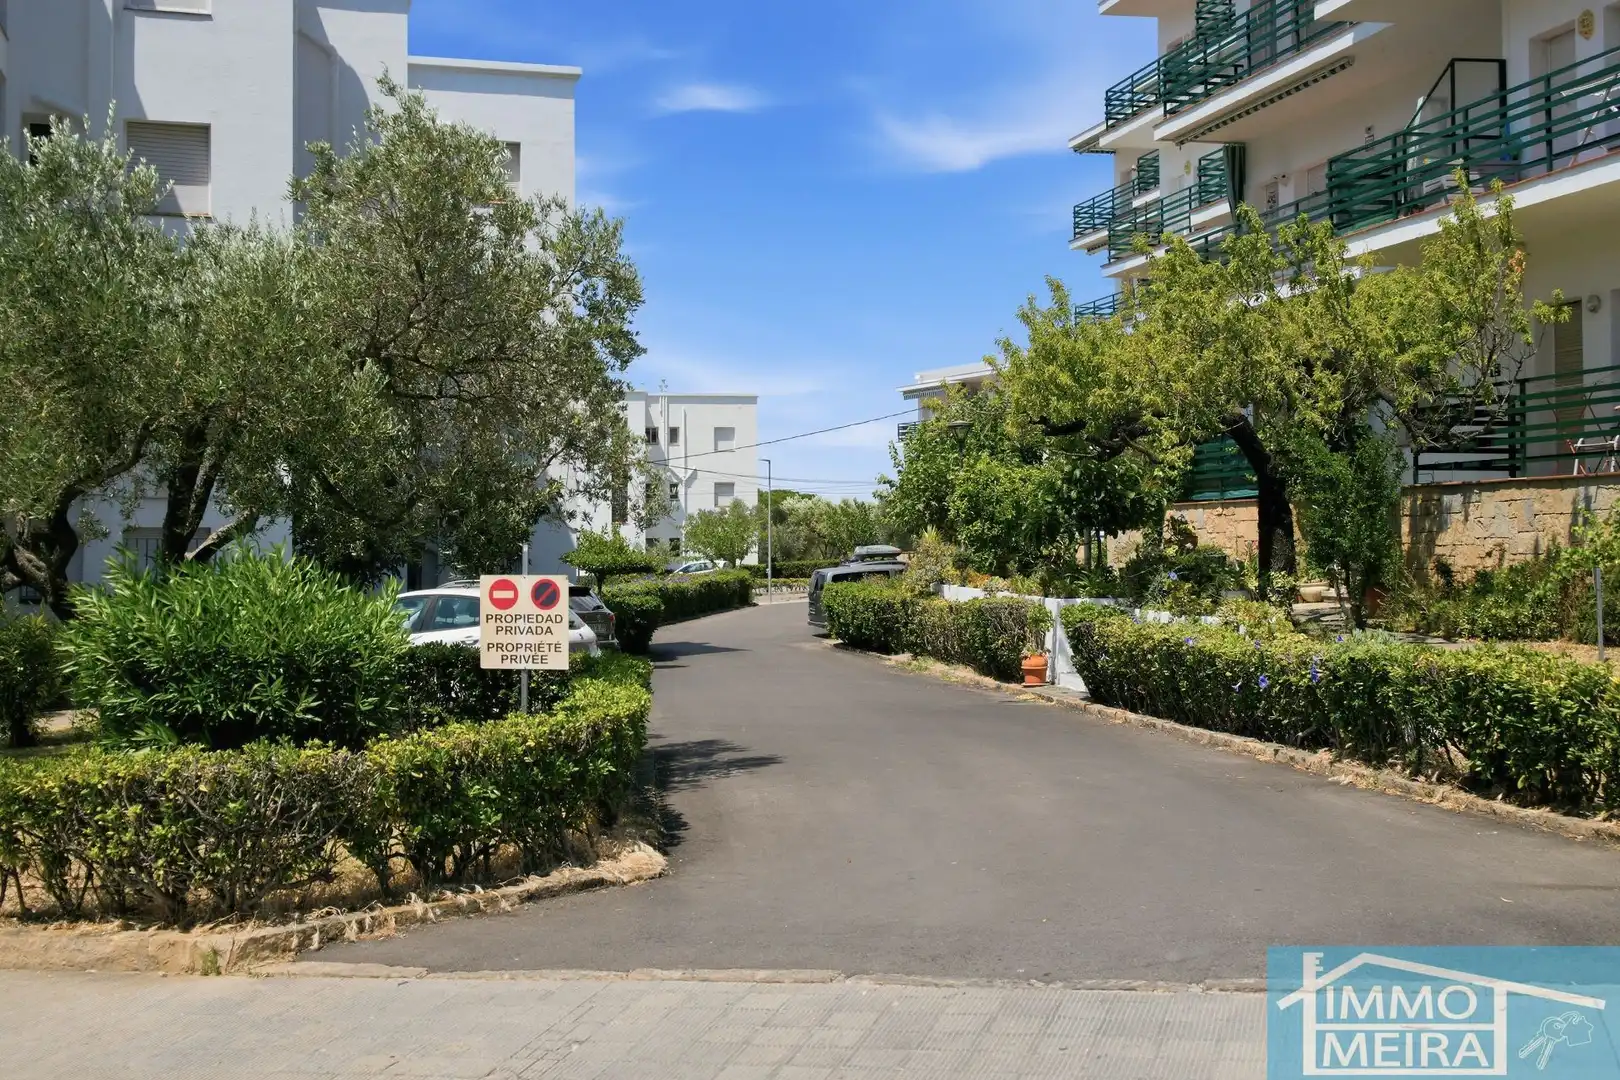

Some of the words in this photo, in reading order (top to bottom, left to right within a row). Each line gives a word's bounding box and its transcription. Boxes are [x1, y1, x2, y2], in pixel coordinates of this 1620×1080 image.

[485, 613, 563, 624] PROPIEDAD
[495, 625, 554, 636] PRIVADA
[486, 641, 563, 653] PROPRIÉTÉ
[500, 652, 549, 665] PRIVÉE
